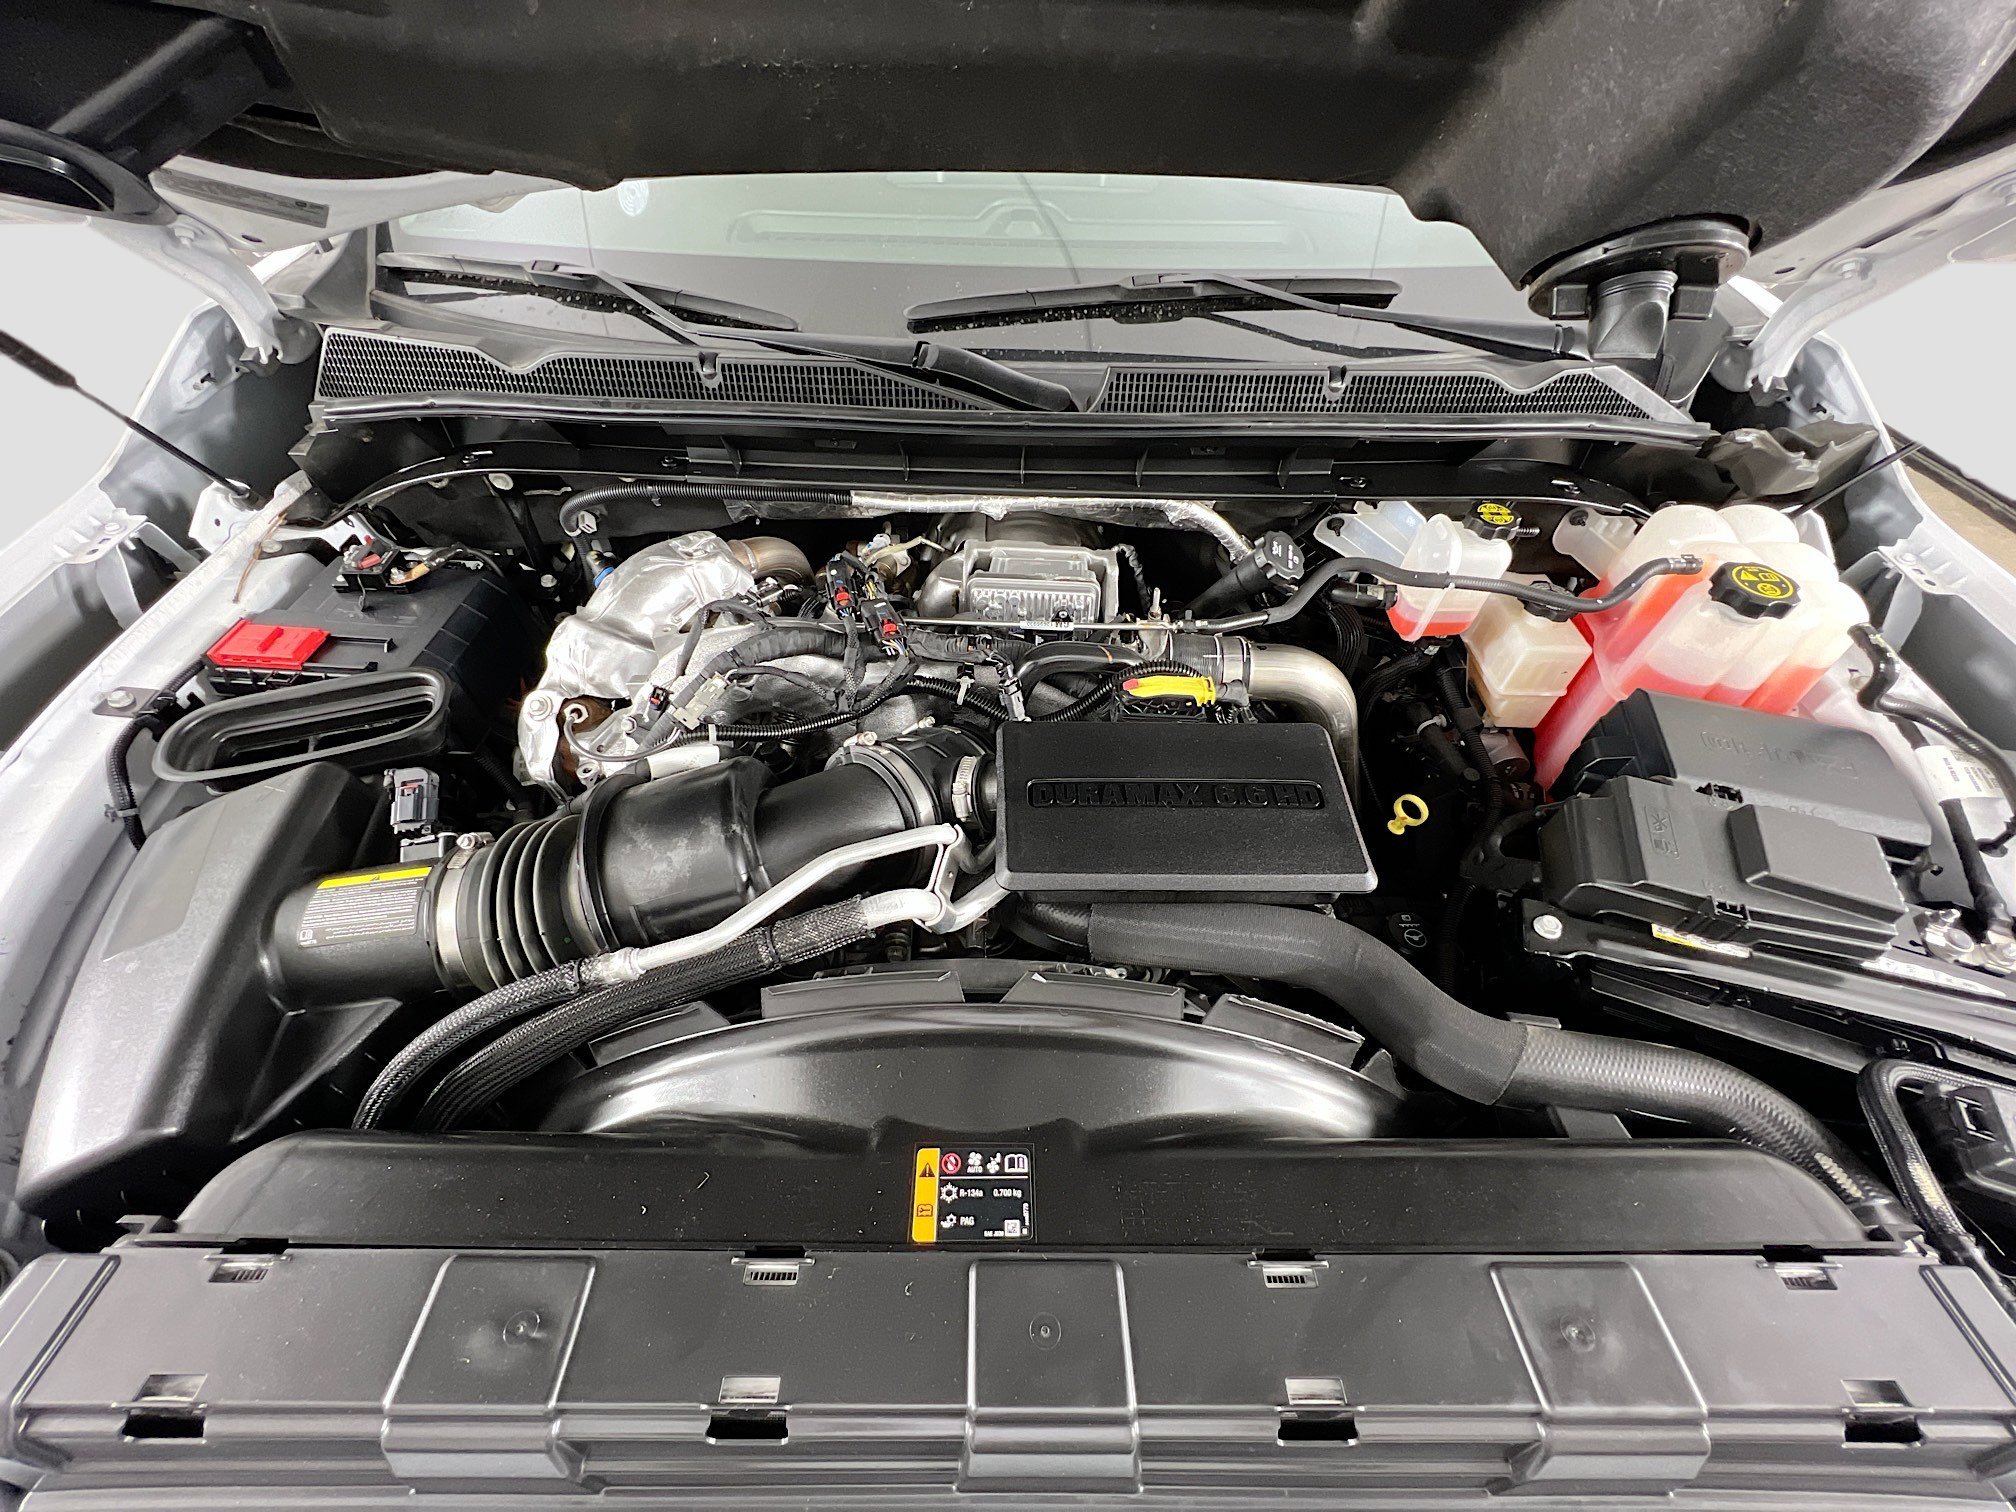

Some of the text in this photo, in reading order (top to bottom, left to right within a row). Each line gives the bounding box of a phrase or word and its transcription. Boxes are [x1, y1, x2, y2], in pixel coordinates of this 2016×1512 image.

[1034, 783, 1321, 806] DURAMAX 6.6 HD
[959, 1189, 1022, 1198] R-134a 0.700 kg
[960, 1216, 975, 1226] PAG
